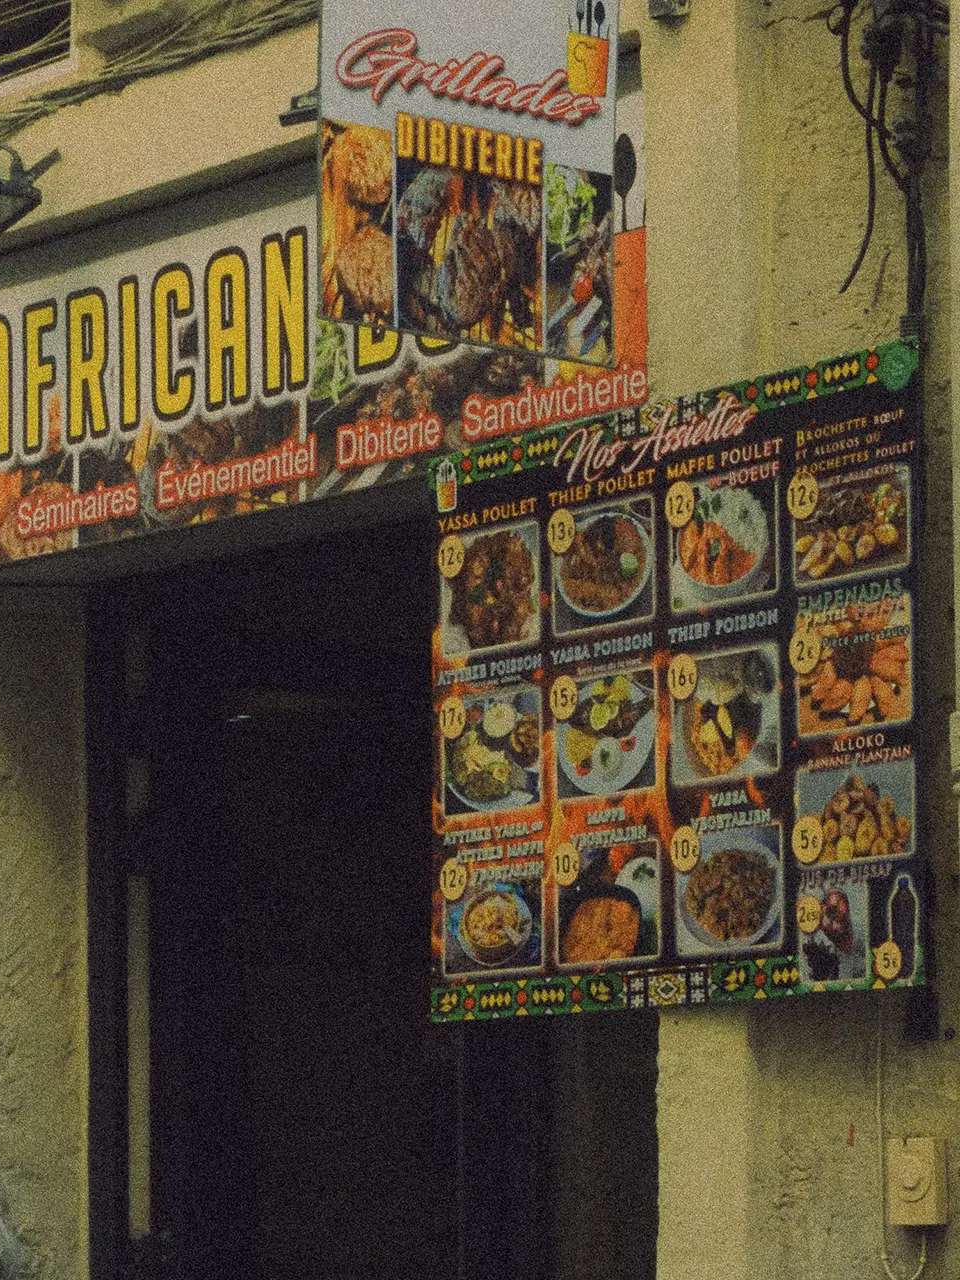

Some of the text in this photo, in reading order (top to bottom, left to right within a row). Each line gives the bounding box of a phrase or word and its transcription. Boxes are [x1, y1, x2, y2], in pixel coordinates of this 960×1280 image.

[335, 27, 602, 126] Grillades
[395, 111, 544, 186] DIBITERIE
[552, 395, 754, 483] Nos Assiettes
[796, 416, 868, 448] BROCHETTE
[16, 484, 138, 536] Séminaires
[156, 437, 317, 506] Événementiel
[337, 412, 441, 467] Dibiterie
[463, 365, 648, 439] Sandwicherie
[666, 438, 784, 480] MAFFE POULET
[596, 469, 657, 500] POULET
[727, 460, 781, 488] BOEUF
[437, 497, 538, 533] YASSA POULET
[714, 608, 779, 636] POISSON
[593, 631, 653, 658] POISSON
[489, 653, 542, 677] POISSON
[831, 733, 886, 754] ALLOKO
[854, 744, 912, 767] PLANTAIN
